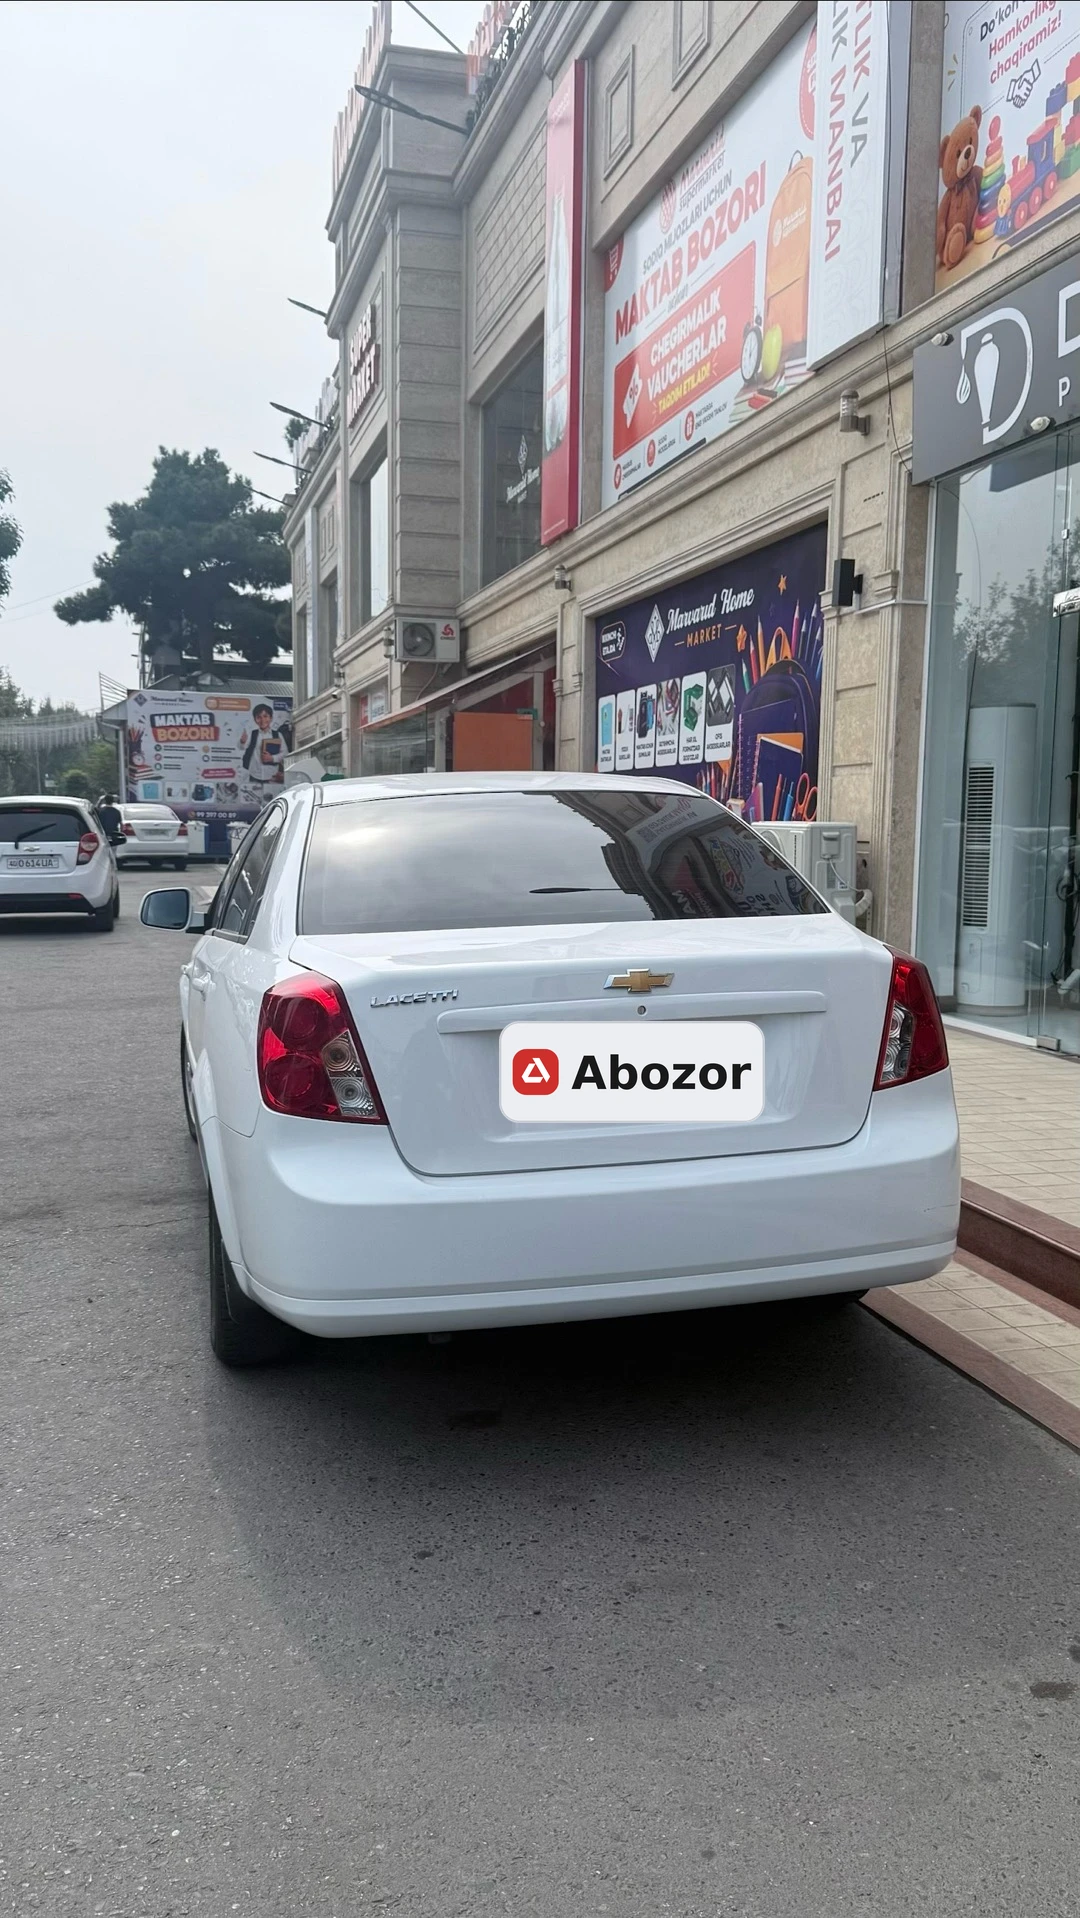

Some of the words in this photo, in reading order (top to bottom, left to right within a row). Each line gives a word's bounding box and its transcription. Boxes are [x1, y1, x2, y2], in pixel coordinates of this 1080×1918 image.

[990, 9, 1061, 84] chaqiramiz!
[850, 91, 870, 168] VA
[703, 168, 732, 213] UCHUN
[825, 64, 847, 263] MANBAI
[616, 246, 683, 345] MAKTAB
[687, 160, 767, 276] BOZORI
[650, 286, 721, 367] CHEGIRMALIK
[647, 316, 727, 401] VAUCHERLAR
[666, 593, 717, 634] Marvarid
[720, 587, 755, 615] Home
[686, 623, 723, 648] MARKET
[154, 714, 211, 727] MAKTAB
[157, 727, 215, 741] BOZORI
[370, 989, 459, 1008] LACETTI
